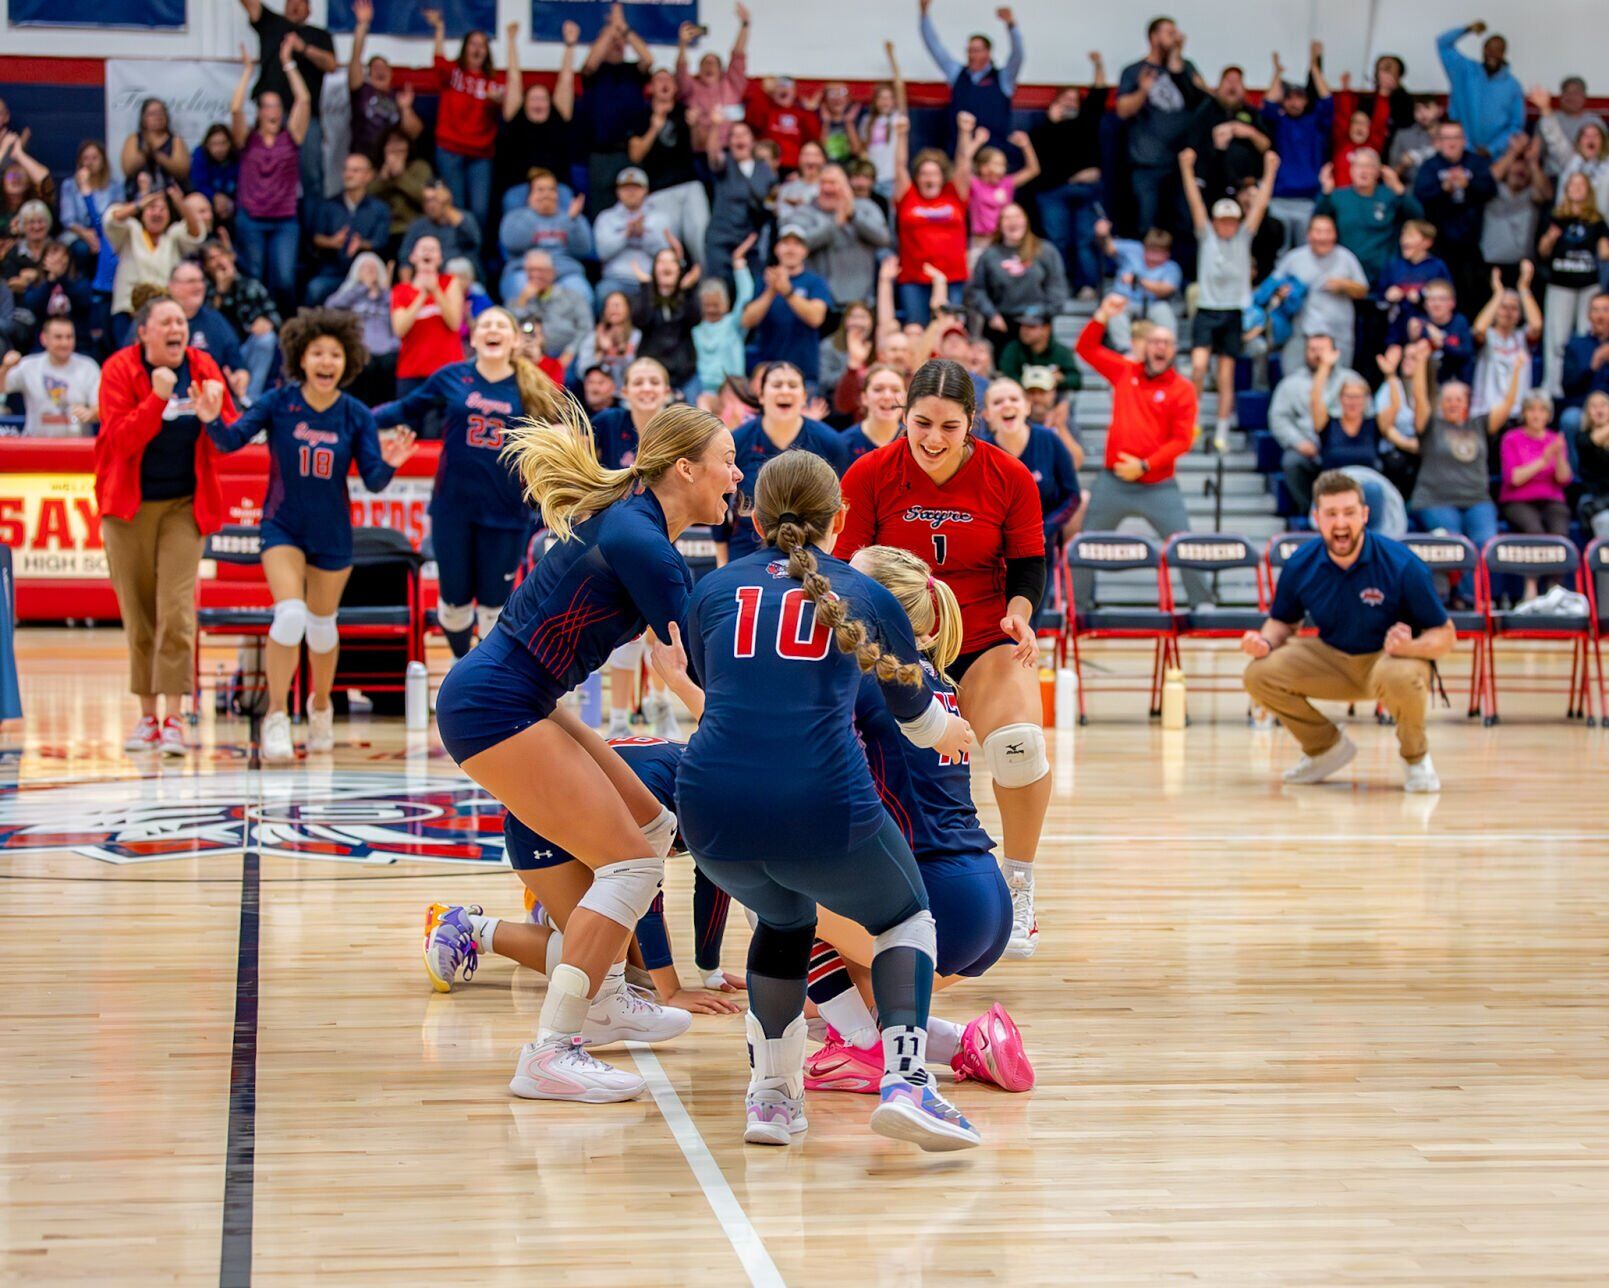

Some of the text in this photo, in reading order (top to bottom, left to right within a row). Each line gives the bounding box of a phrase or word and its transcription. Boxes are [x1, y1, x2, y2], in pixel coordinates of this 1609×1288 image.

[466, 414, 504, 450] 23
[299, 445, 334, 480] 18
[902, 504, 974, 530] Sayre
[24, 556, 76, 570] HIGH
[931, 534, 947, 566] 1
[734, 585, 840, 662] 10
[893, 1035, 919, 1056] 11
